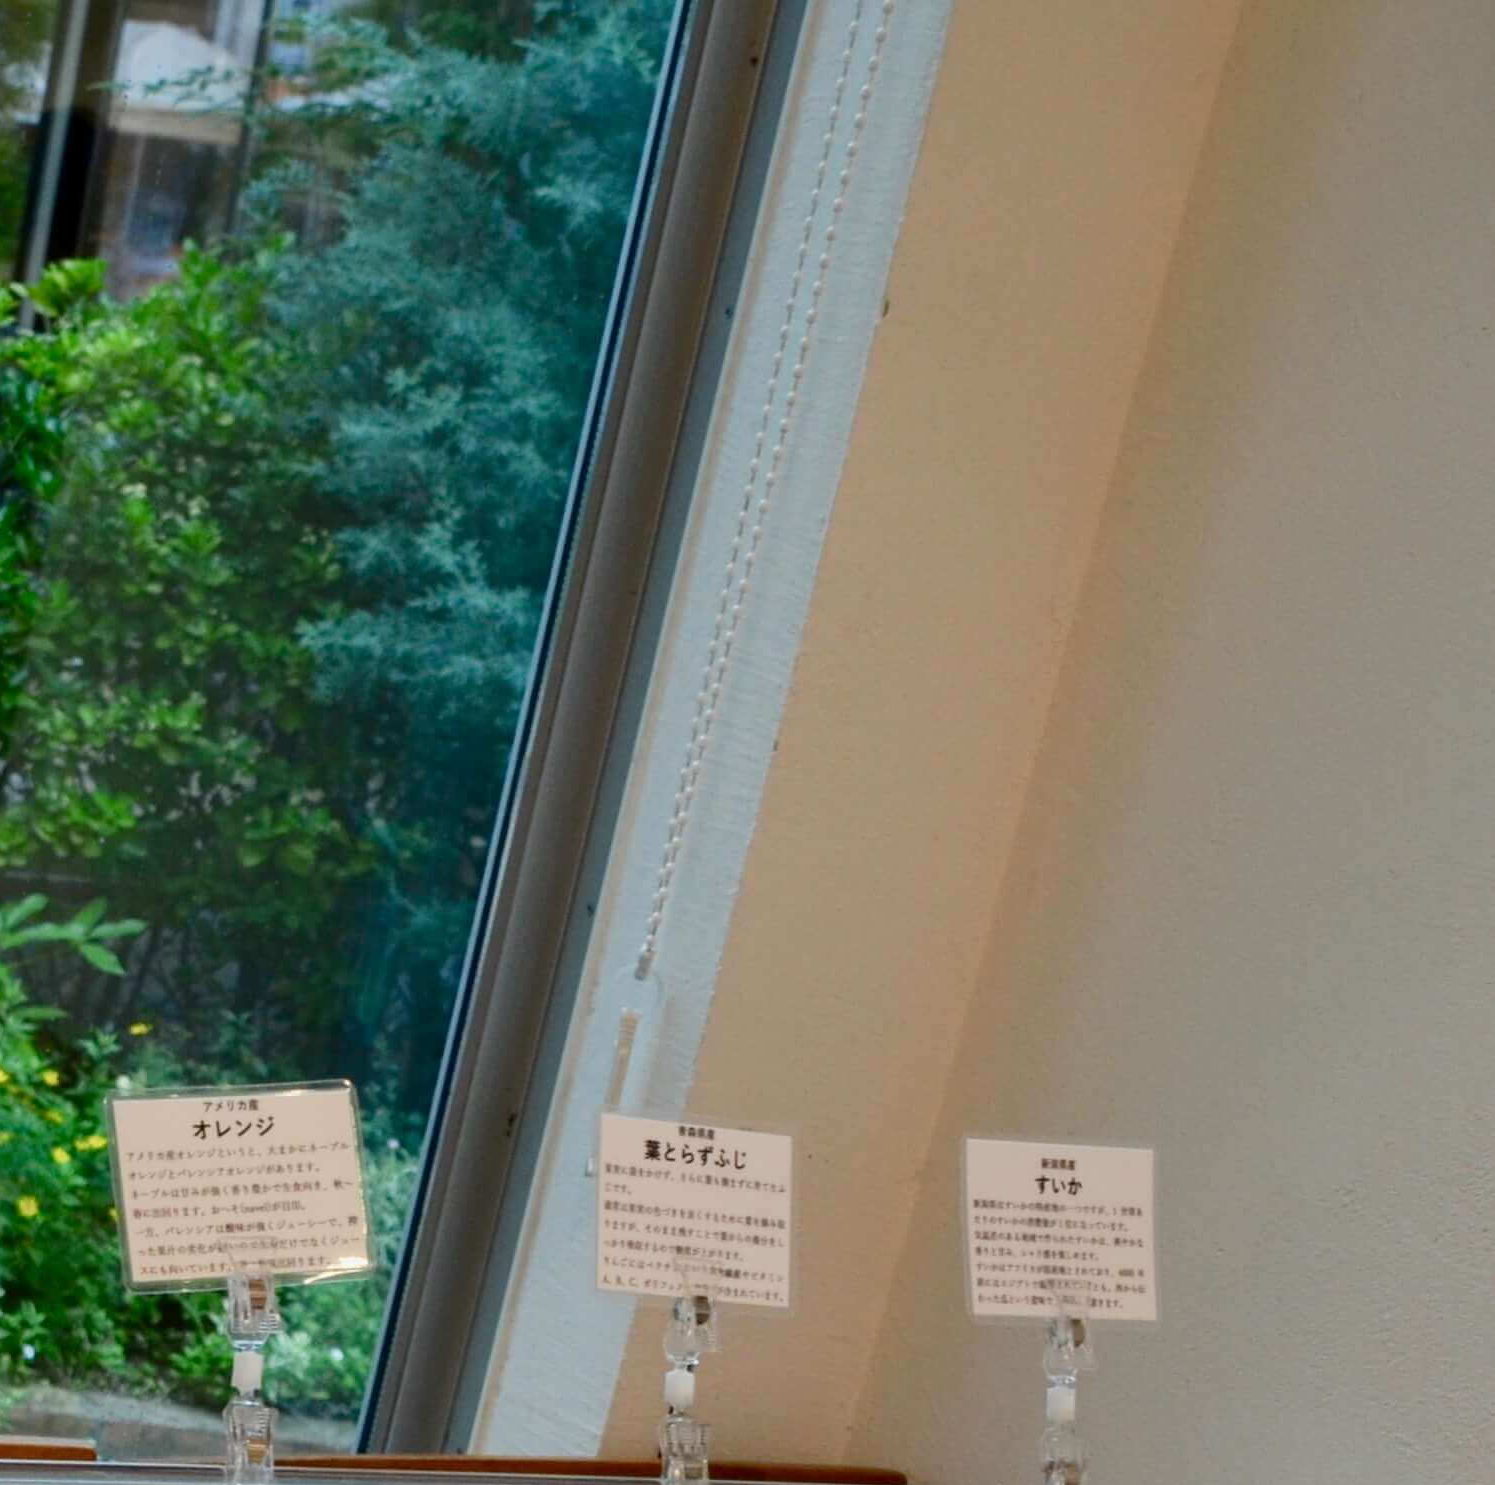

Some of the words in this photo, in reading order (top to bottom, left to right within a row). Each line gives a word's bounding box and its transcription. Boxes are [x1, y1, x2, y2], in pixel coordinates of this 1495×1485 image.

[192, 1116, 274, 1140] オレンジ
[644, 1140, 746, 1169] 葉とらずふじ
[1035, 1176, 1083, 1195] すいか
